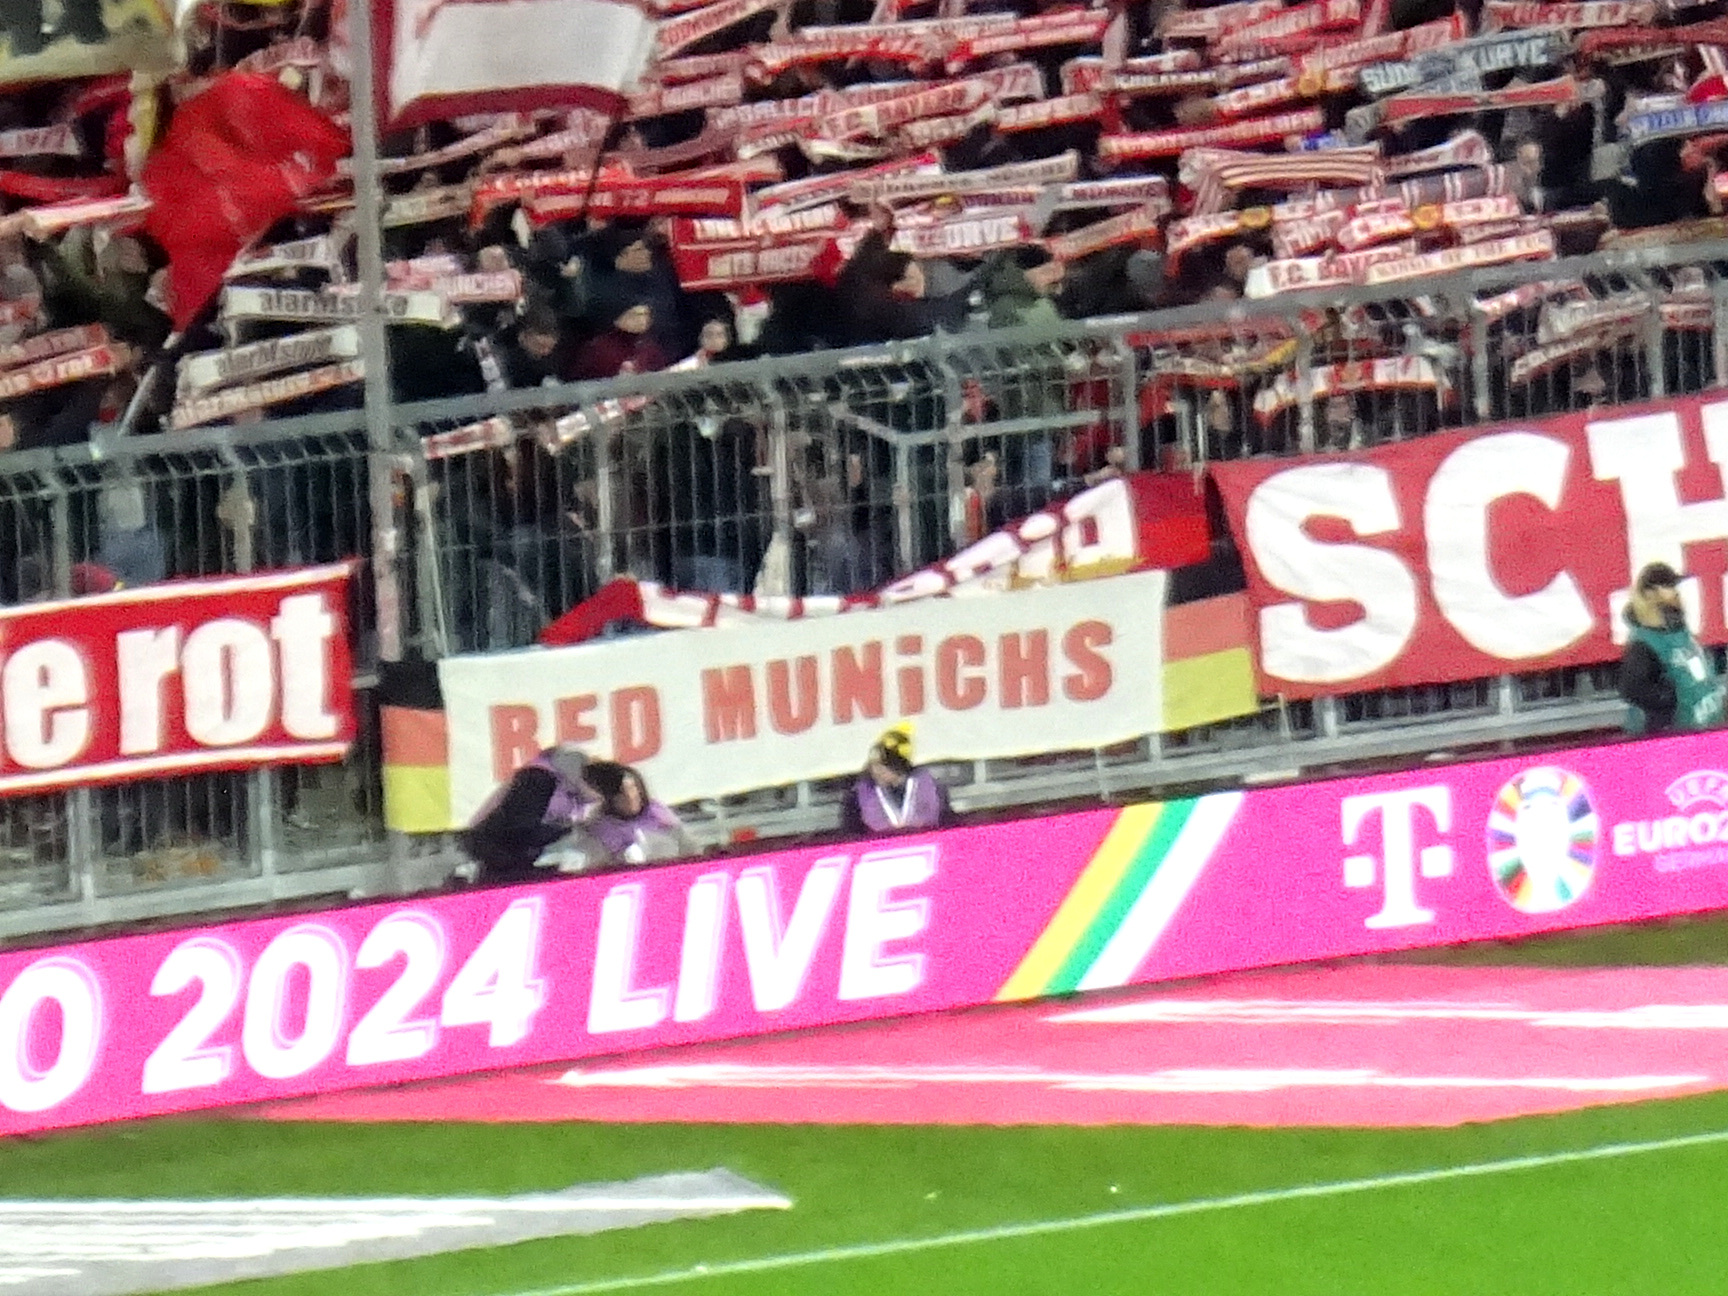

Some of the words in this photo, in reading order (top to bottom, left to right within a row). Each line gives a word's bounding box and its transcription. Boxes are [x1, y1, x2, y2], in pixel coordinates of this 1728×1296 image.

[116, 591, 339, 756] rot
[143, 896, 548, 1096] 2024
[586, 845, 938, 1035] LIVE
